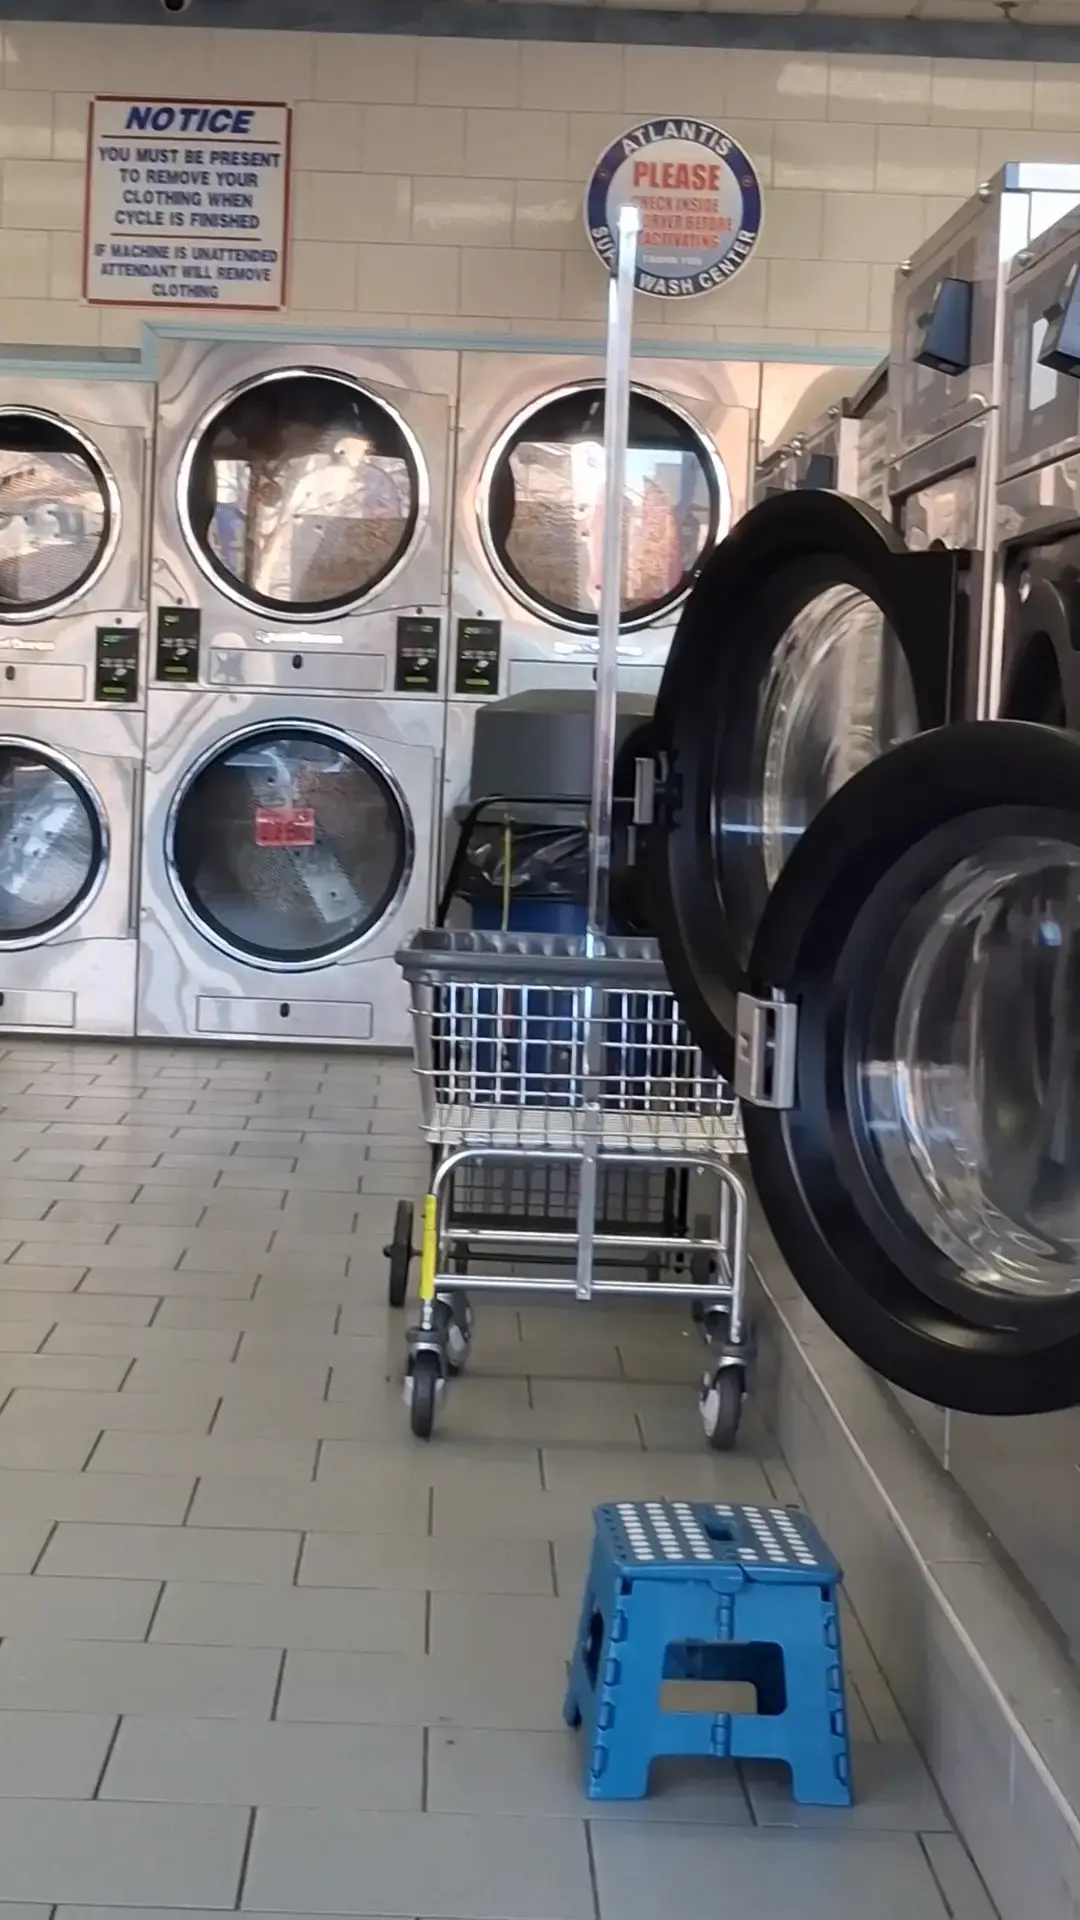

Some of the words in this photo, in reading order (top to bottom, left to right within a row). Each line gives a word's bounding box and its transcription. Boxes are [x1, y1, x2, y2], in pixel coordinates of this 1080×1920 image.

[125, 106, 255, 134] NOTICE
[621, 121, 734, 156] ATLANTIS
[98, 147, 131, 162] YOU
[136, 149, 179, 164] MUST
[184, 150, 204, 165] BE
[210, 152, 280, 168] PRESENT
[119, 169, 141, 183] TO
[146, 170, 211, 186] REMOVE
[216, 172, 258, 188] YOUR
[633, 161, 721, 191] PLEASE
[122, 190, 202, 206] CLOTHING
[208, 193, 253, 208] WHEN
[114, 210, 164, 226] CYCLE
[170, 212, 184, 227] IS
[190, 213, 260, 229] FINISHED
[94, 244, 107, 257] IF
[110, 245, 169, 259] MACHINE
[174, 247, 188, 260] IS
[192, 248, 278, 263] UNATTENDED
[640, 273, 694, 295] WASH
[698, 230, 756, 289] CENTER
[101, 264, 177, 278] ATTENDANT
[182, 266, 212, 280] WILL
[217, 267, 272, 282] REMOVE
[152, 283, 219, 298] CLOTHING
